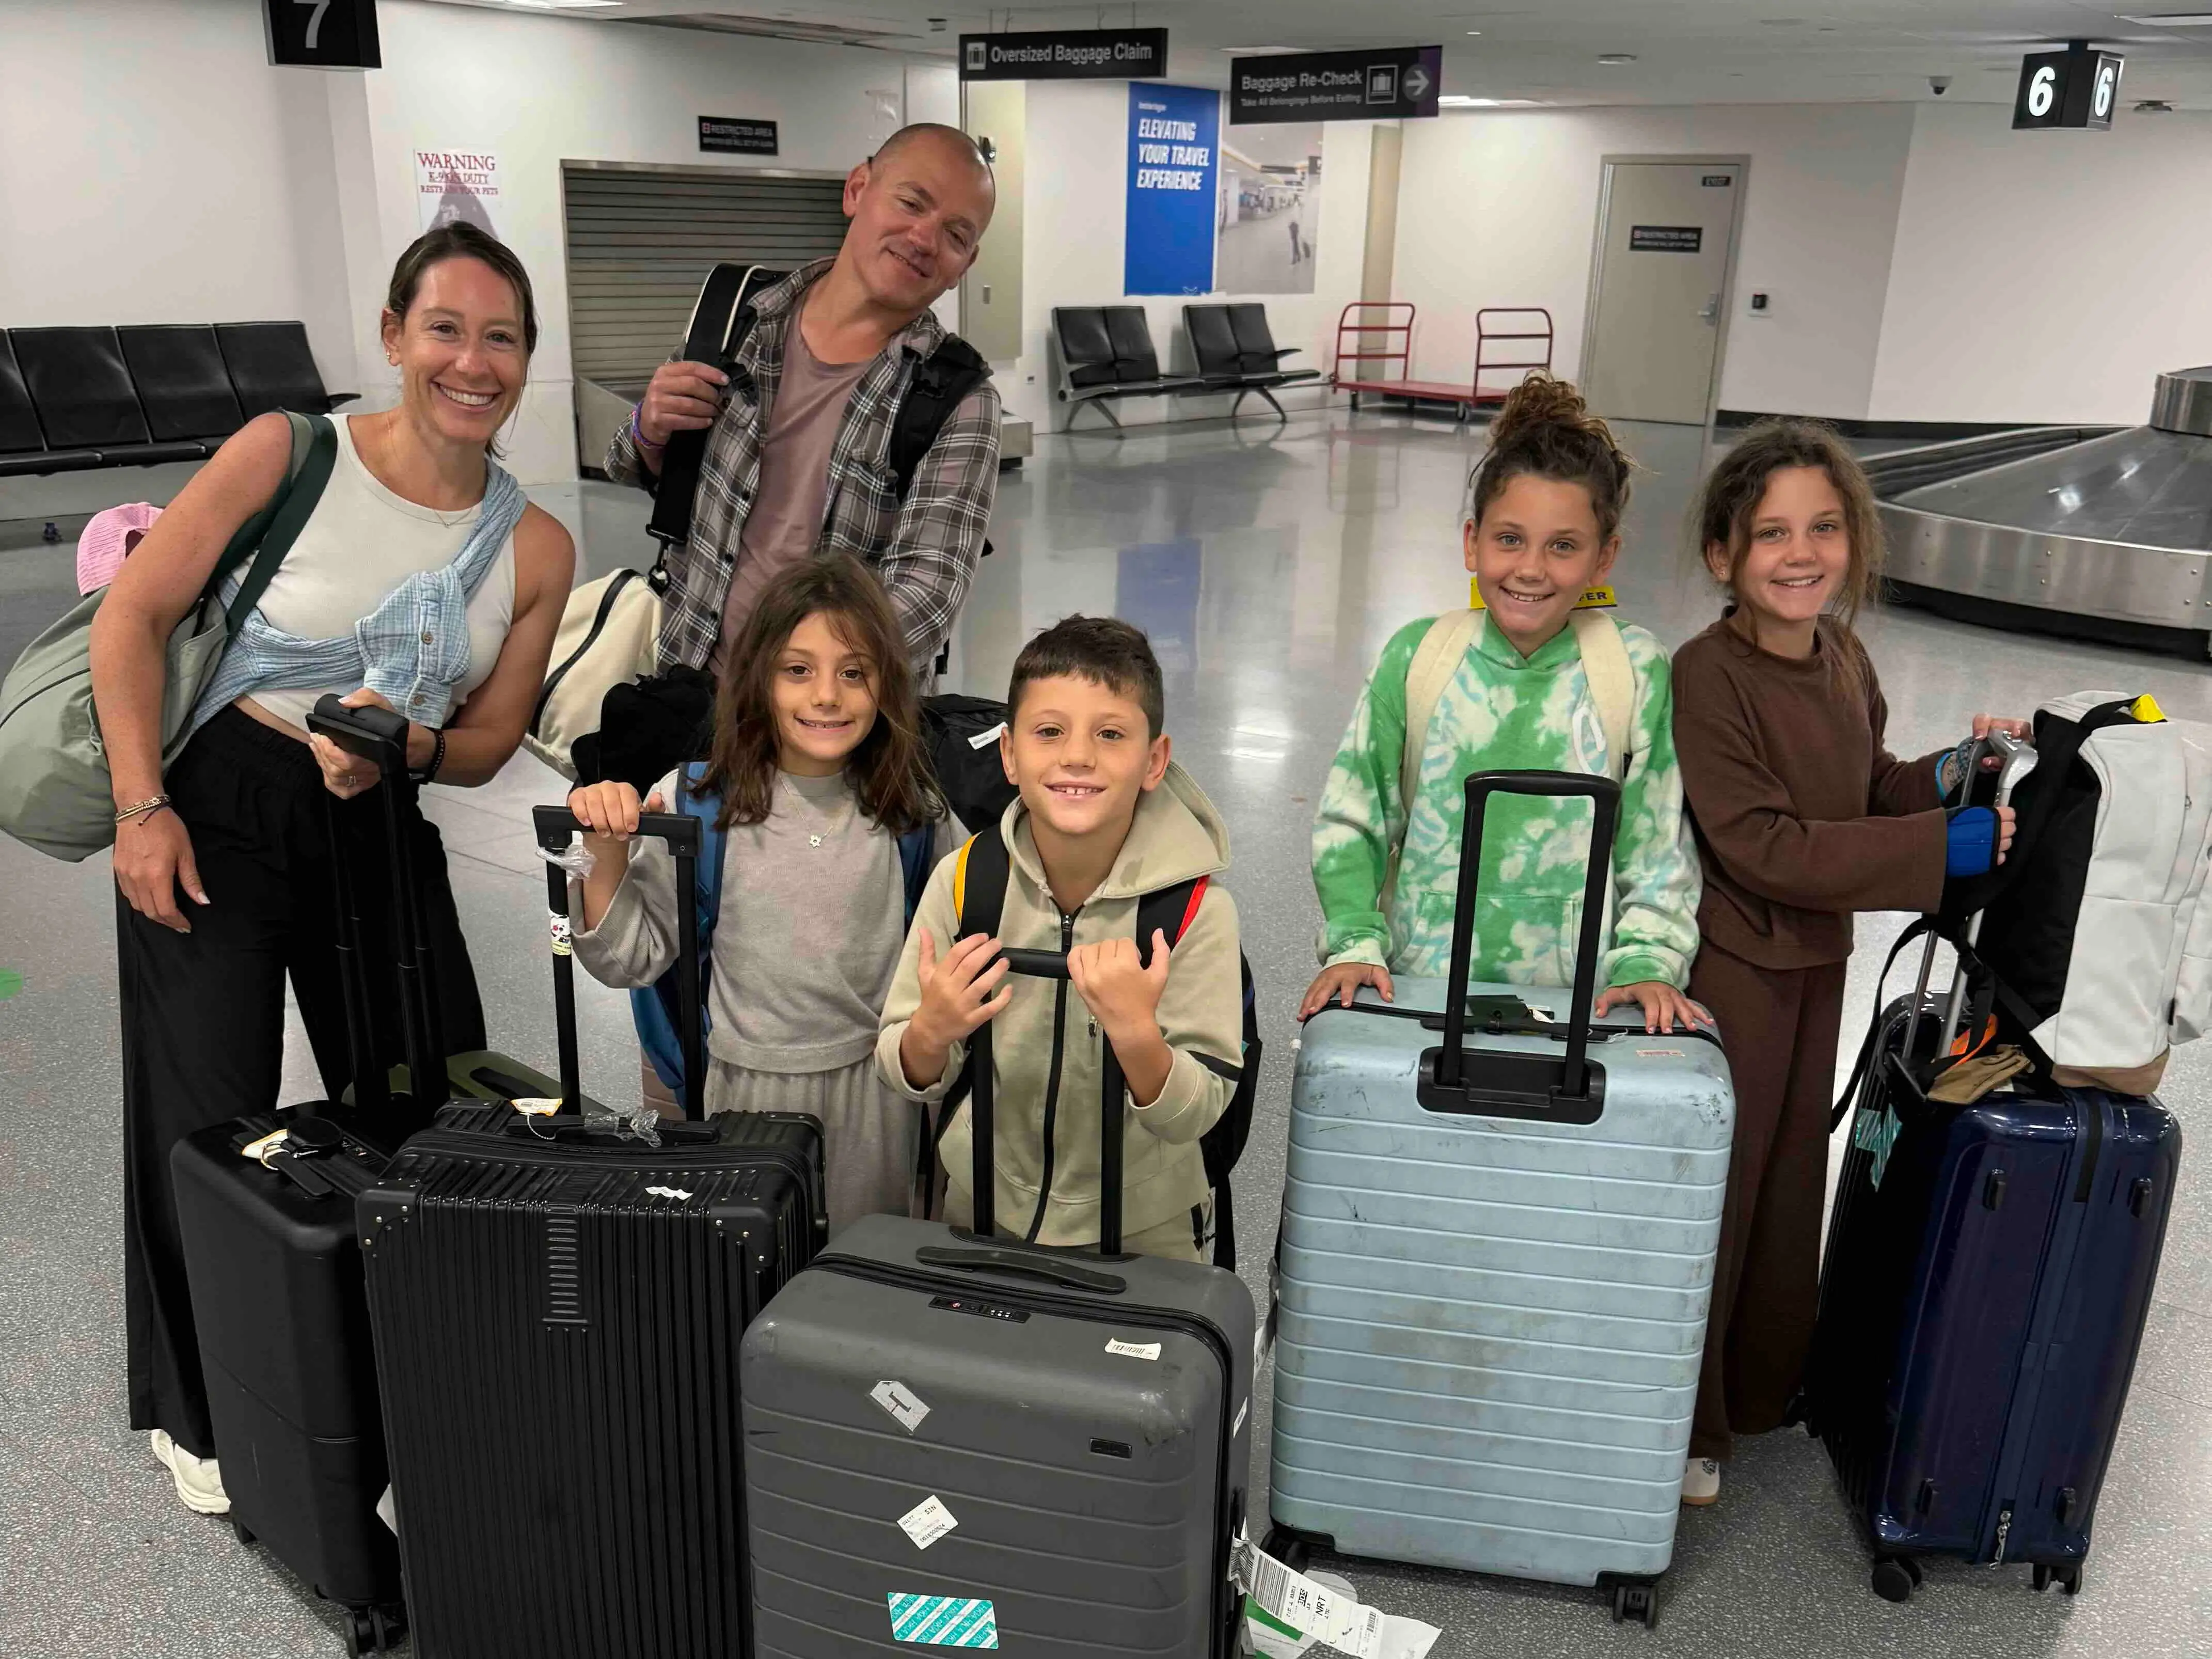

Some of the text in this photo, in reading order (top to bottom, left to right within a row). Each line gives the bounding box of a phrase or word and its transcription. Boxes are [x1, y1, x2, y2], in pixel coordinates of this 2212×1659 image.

[293, 0, 330, 49] 7
[991, 42, 1152, 65] Oversized Baggage Claim
[1242, 70, 1362, 92] Baggage Re-Check
[2028, 66, 2055, 117] 6
[2095, 67, 2113, 117] 6
[1138, 118, 1196, 141] ELEVATING
[417, 153, 496, 171] WARNING
[1139, 144, 1210, 167] YOUR TRAVEL
[1137, 169, 1203, 191] EXPERIENCE
[925, 1505, 937, 1514] SIN
[1315, 1594, 1326, 1616] NRT
